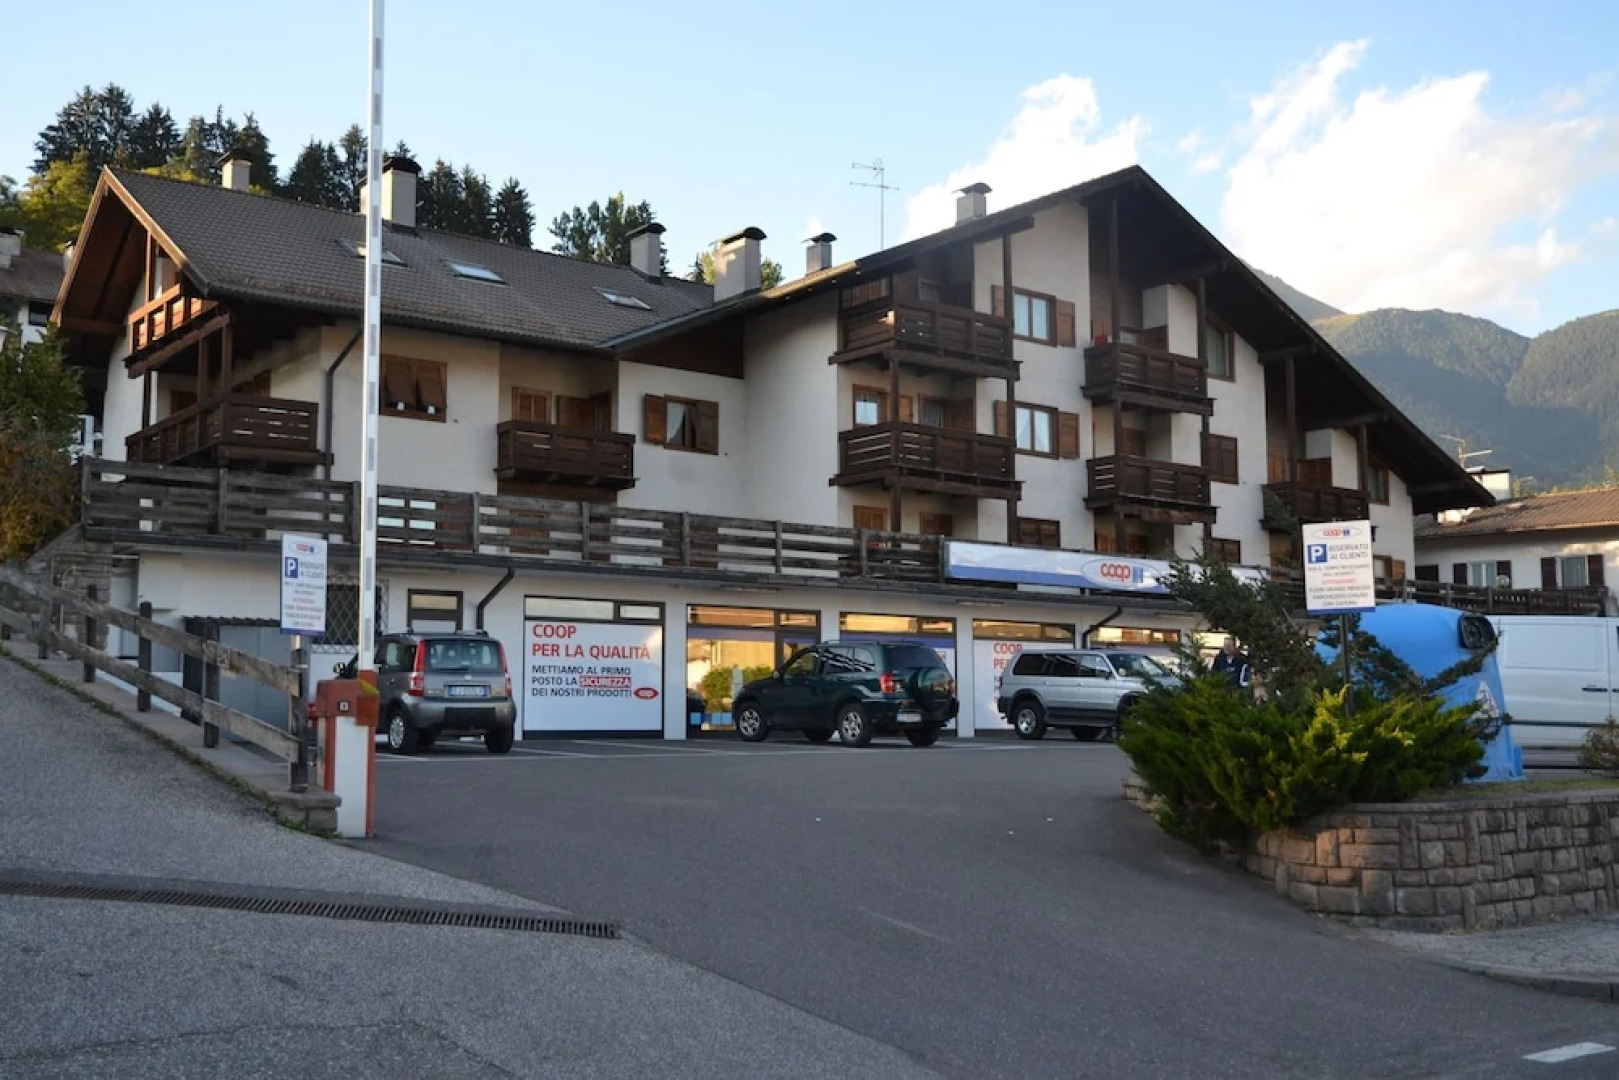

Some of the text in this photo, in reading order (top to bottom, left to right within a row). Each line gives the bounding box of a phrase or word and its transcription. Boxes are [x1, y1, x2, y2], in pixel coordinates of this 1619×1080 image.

[1310, 546, 1324, 563] P
[287, 557, 297, 577] P
[1101, 562, 1131, 583] coop
[532, 624, 577, 639] COOP
[532, 643, 651, 660] PER LA QUALITÀ
[531, 665, 631, 676] METTIAMO AL PRIMO
[531, 676, 631, 688] POSTO LA SICUREZZA
[531, 687, 632, 698] DEI NOSTRI PRODOTTI
